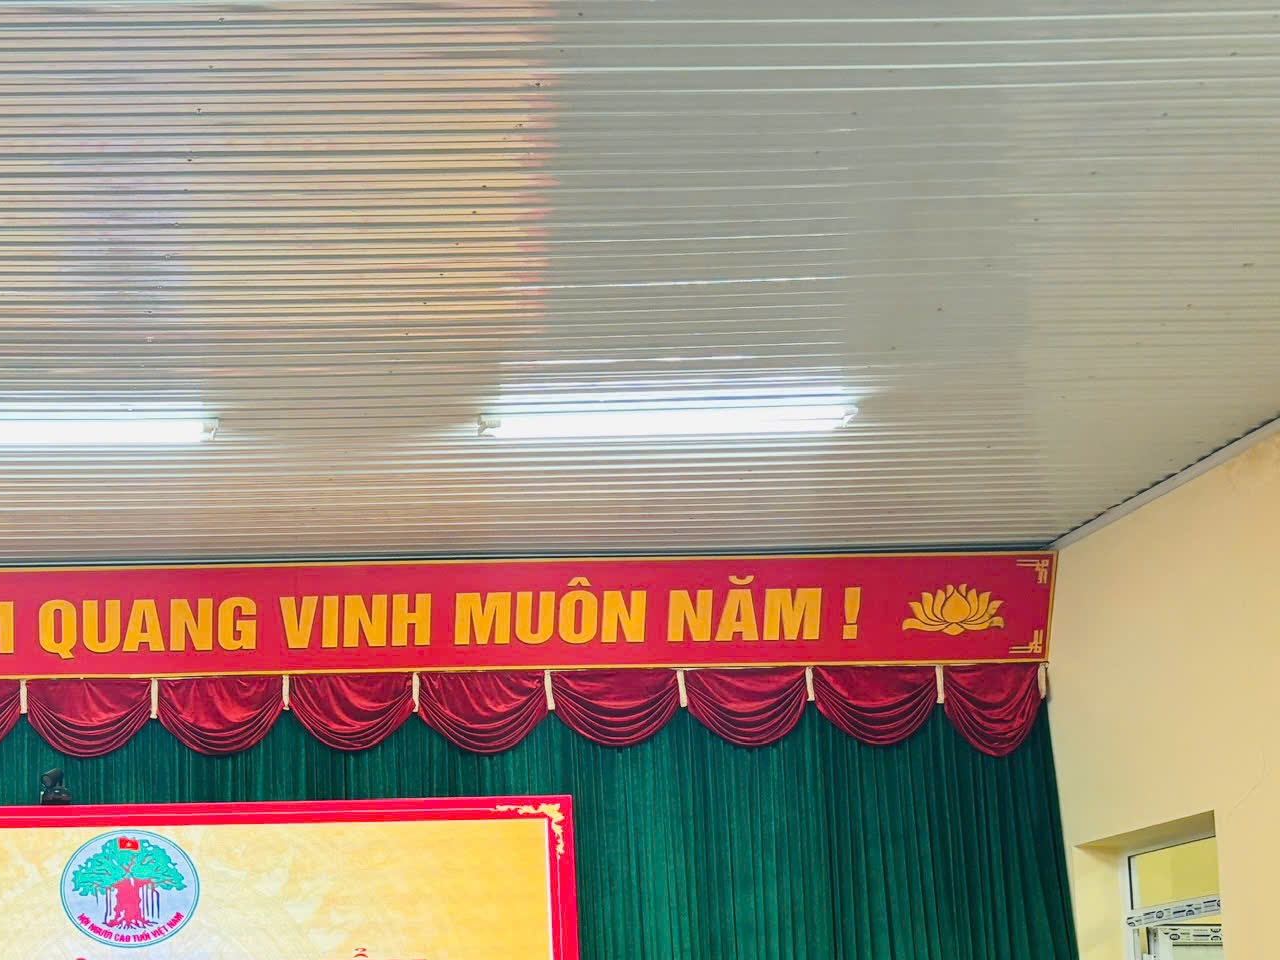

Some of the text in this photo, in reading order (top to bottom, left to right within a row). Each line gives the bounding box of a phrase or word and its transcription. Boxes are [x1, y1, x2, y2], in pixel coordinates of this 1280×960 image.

[38, 596, 257, 659] QUANG
[279, 593, 431, 649] VINH
[454, 576, 647, 645] MUÔN
[667, 575, 822, 642] NĂM
[842, 586, 861, 640] !
[114, 934, 130, 942] CAO
